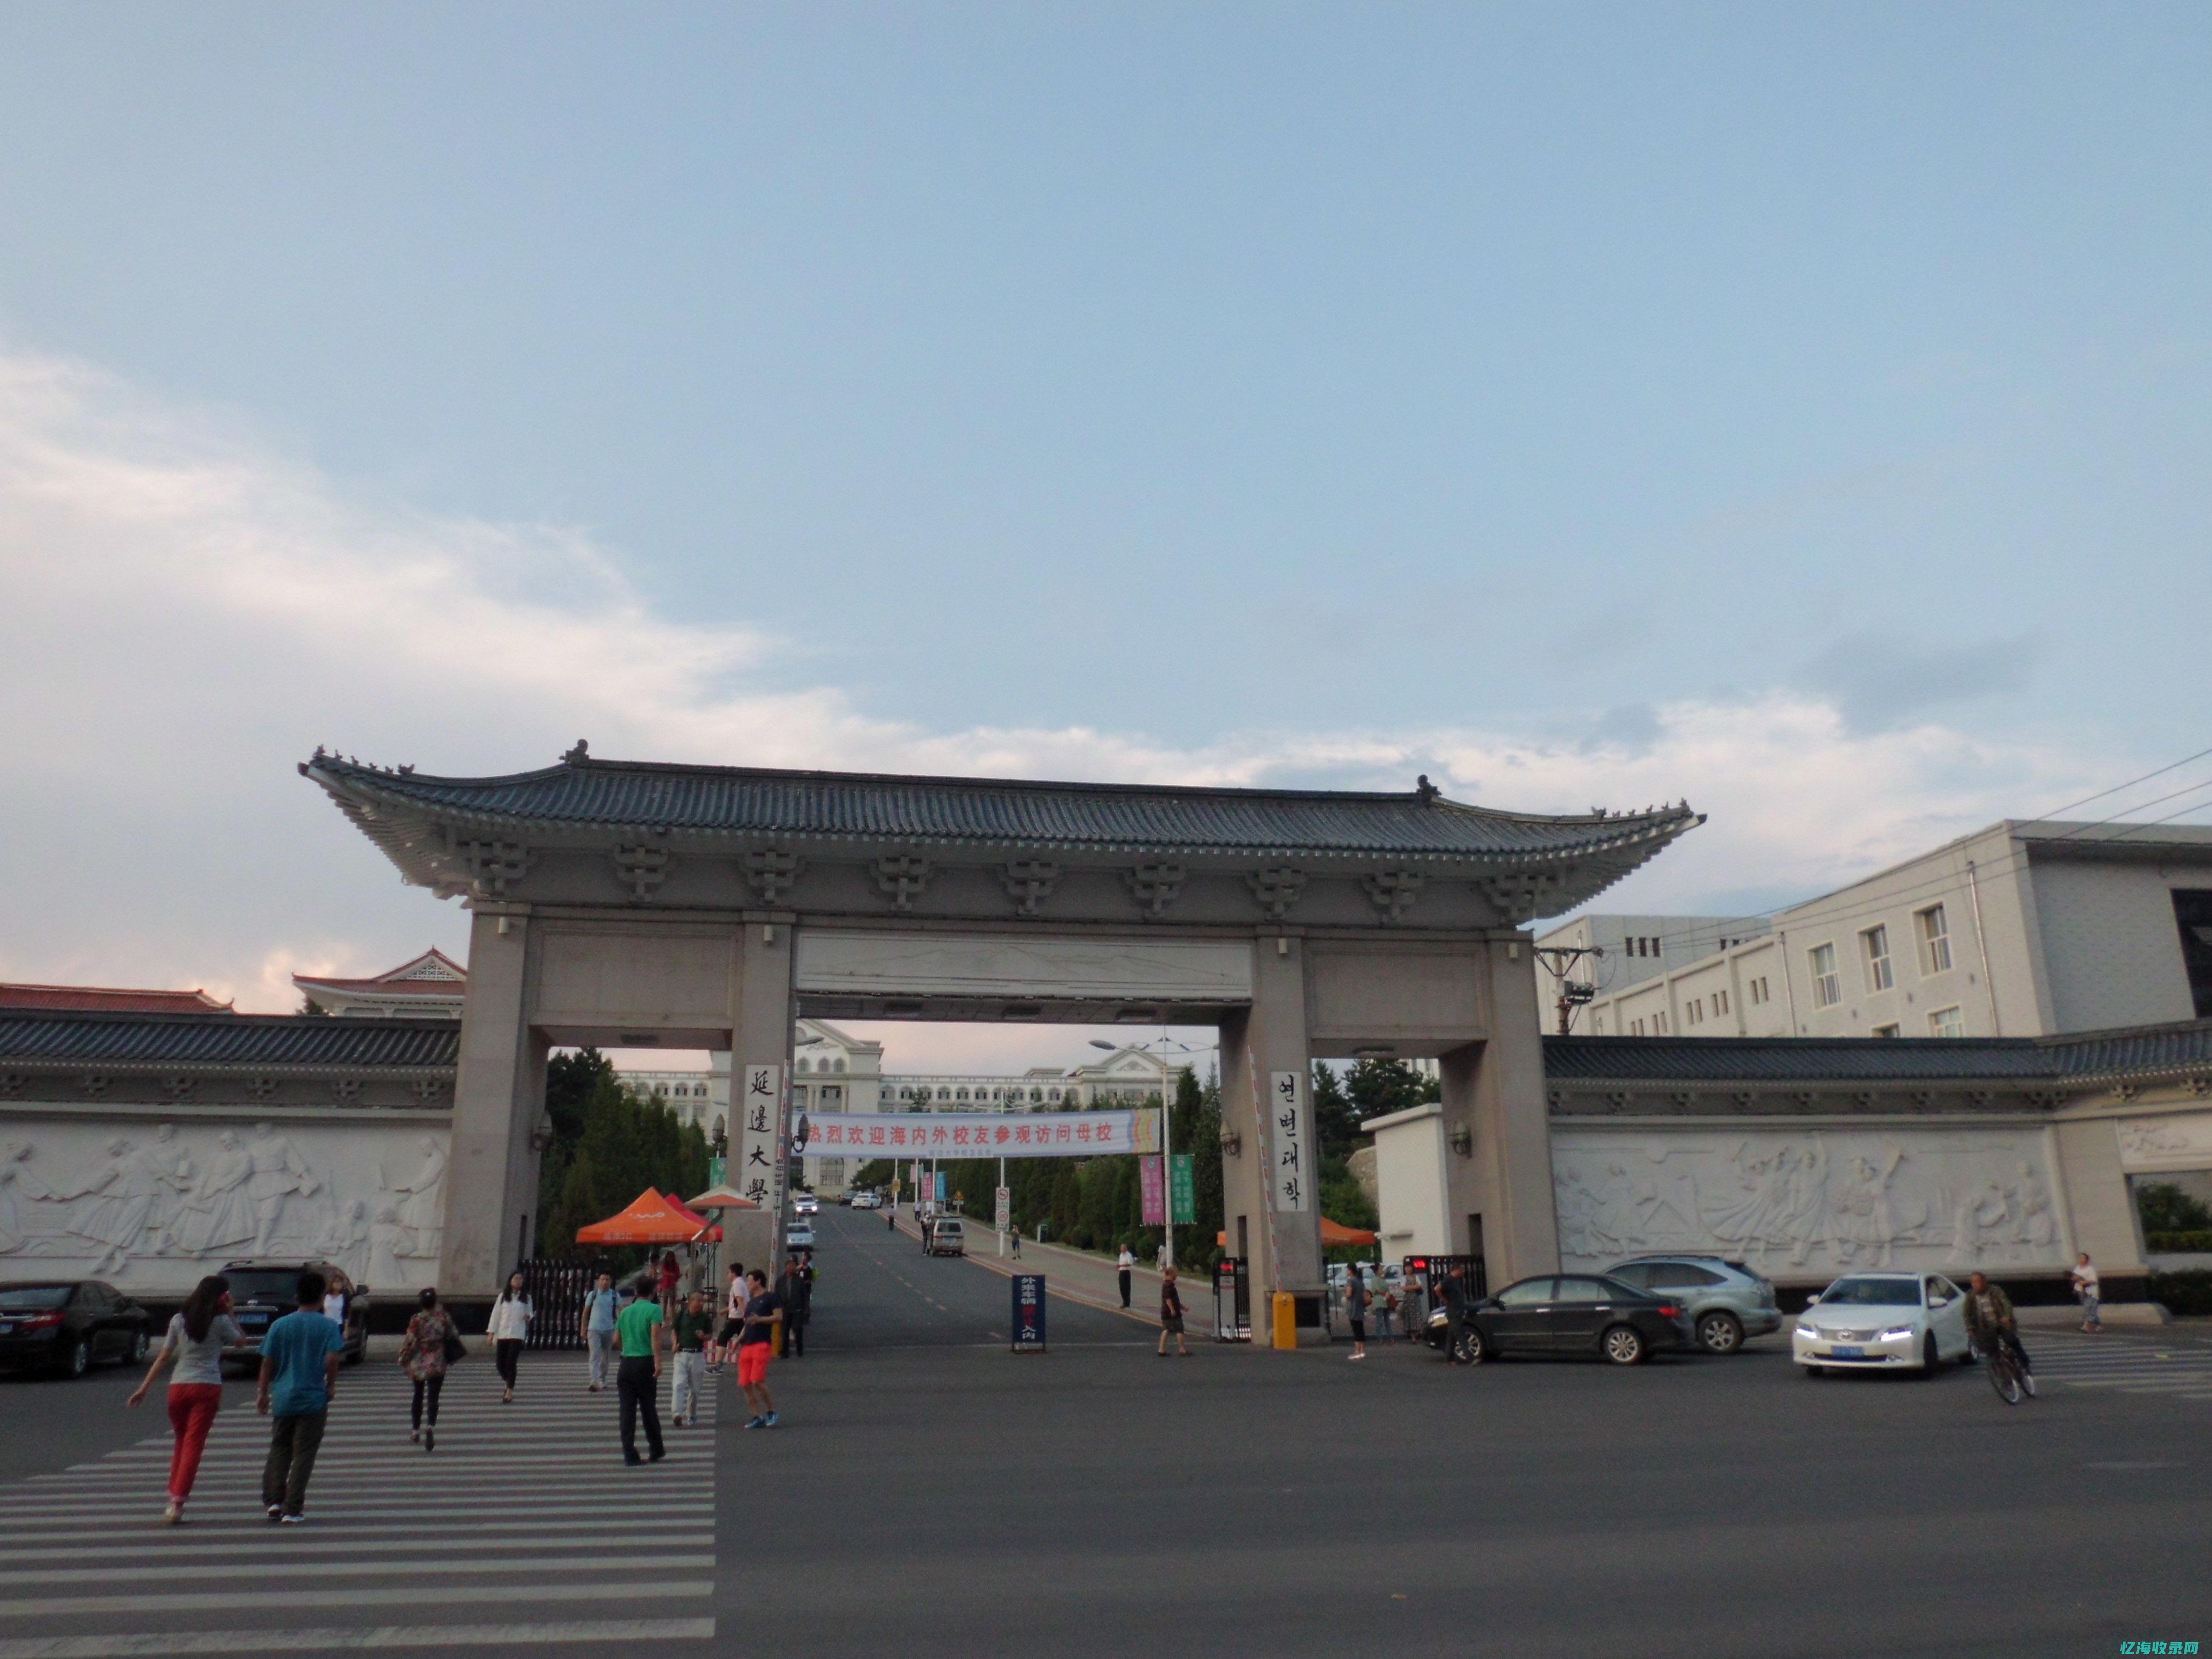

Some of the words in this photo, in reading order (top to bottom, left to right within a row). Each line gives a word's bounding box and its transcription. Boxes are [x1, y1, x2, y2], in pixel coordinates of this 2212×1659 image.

[746, 1070, 774, 1204] 延邊大學
[809, 1121, 1112, 1145] 热烈欢迎海内外校友参观访问母校
[1279, 1074, 1301, 1209] 연변대학
